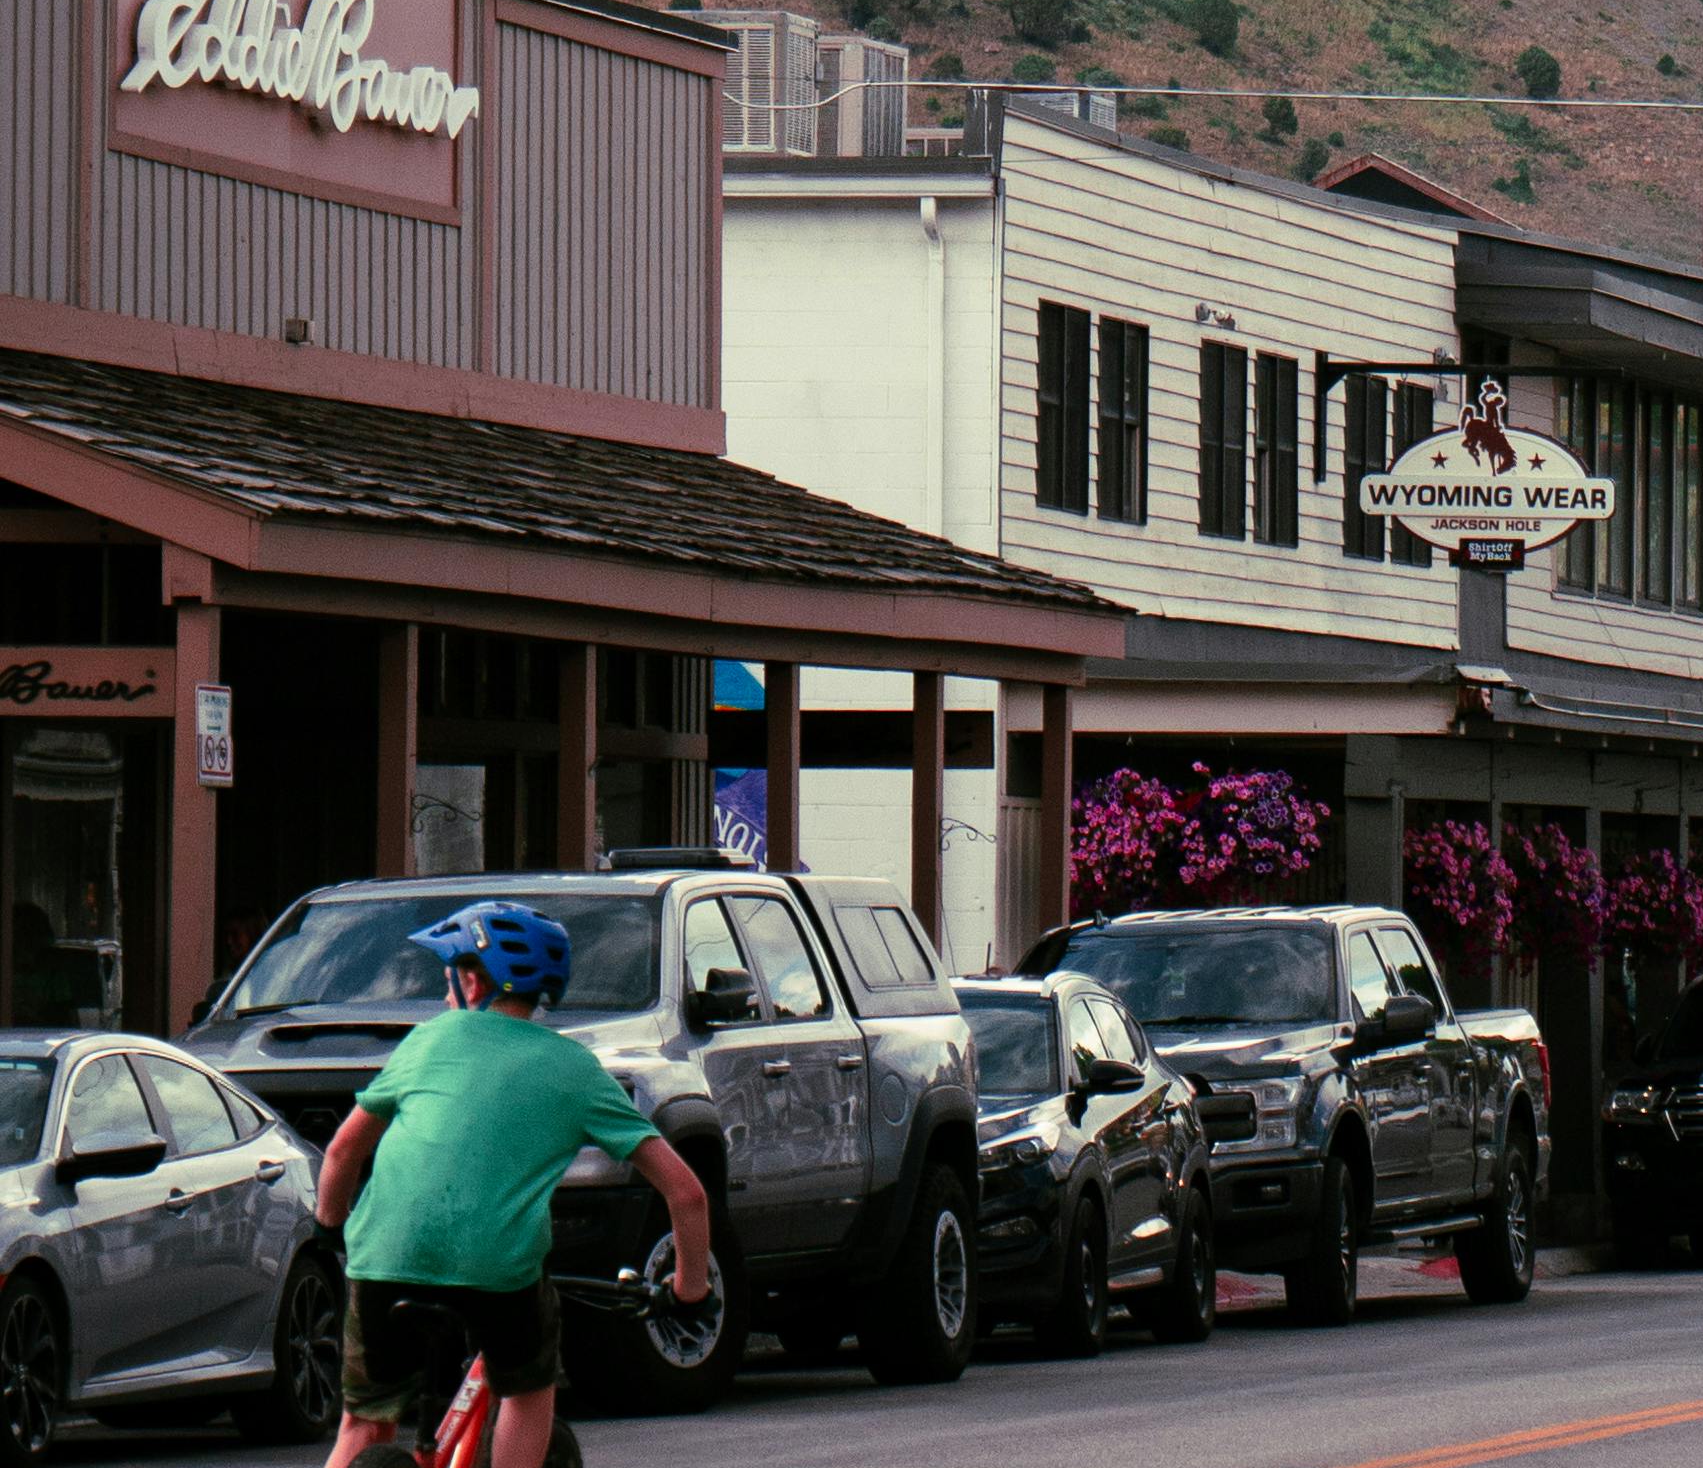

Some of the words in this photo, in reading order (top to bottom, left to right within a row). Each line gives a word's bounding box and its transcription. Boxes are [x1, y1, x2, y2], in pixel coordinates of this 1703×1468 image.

[1368, 484, 1513, 507] WYOMING
[1523, 487, 1607, 510] WEAR
[1431, 518, 1500, 532] JACKSON
[1505, 519, 1542, 532] HOLE
